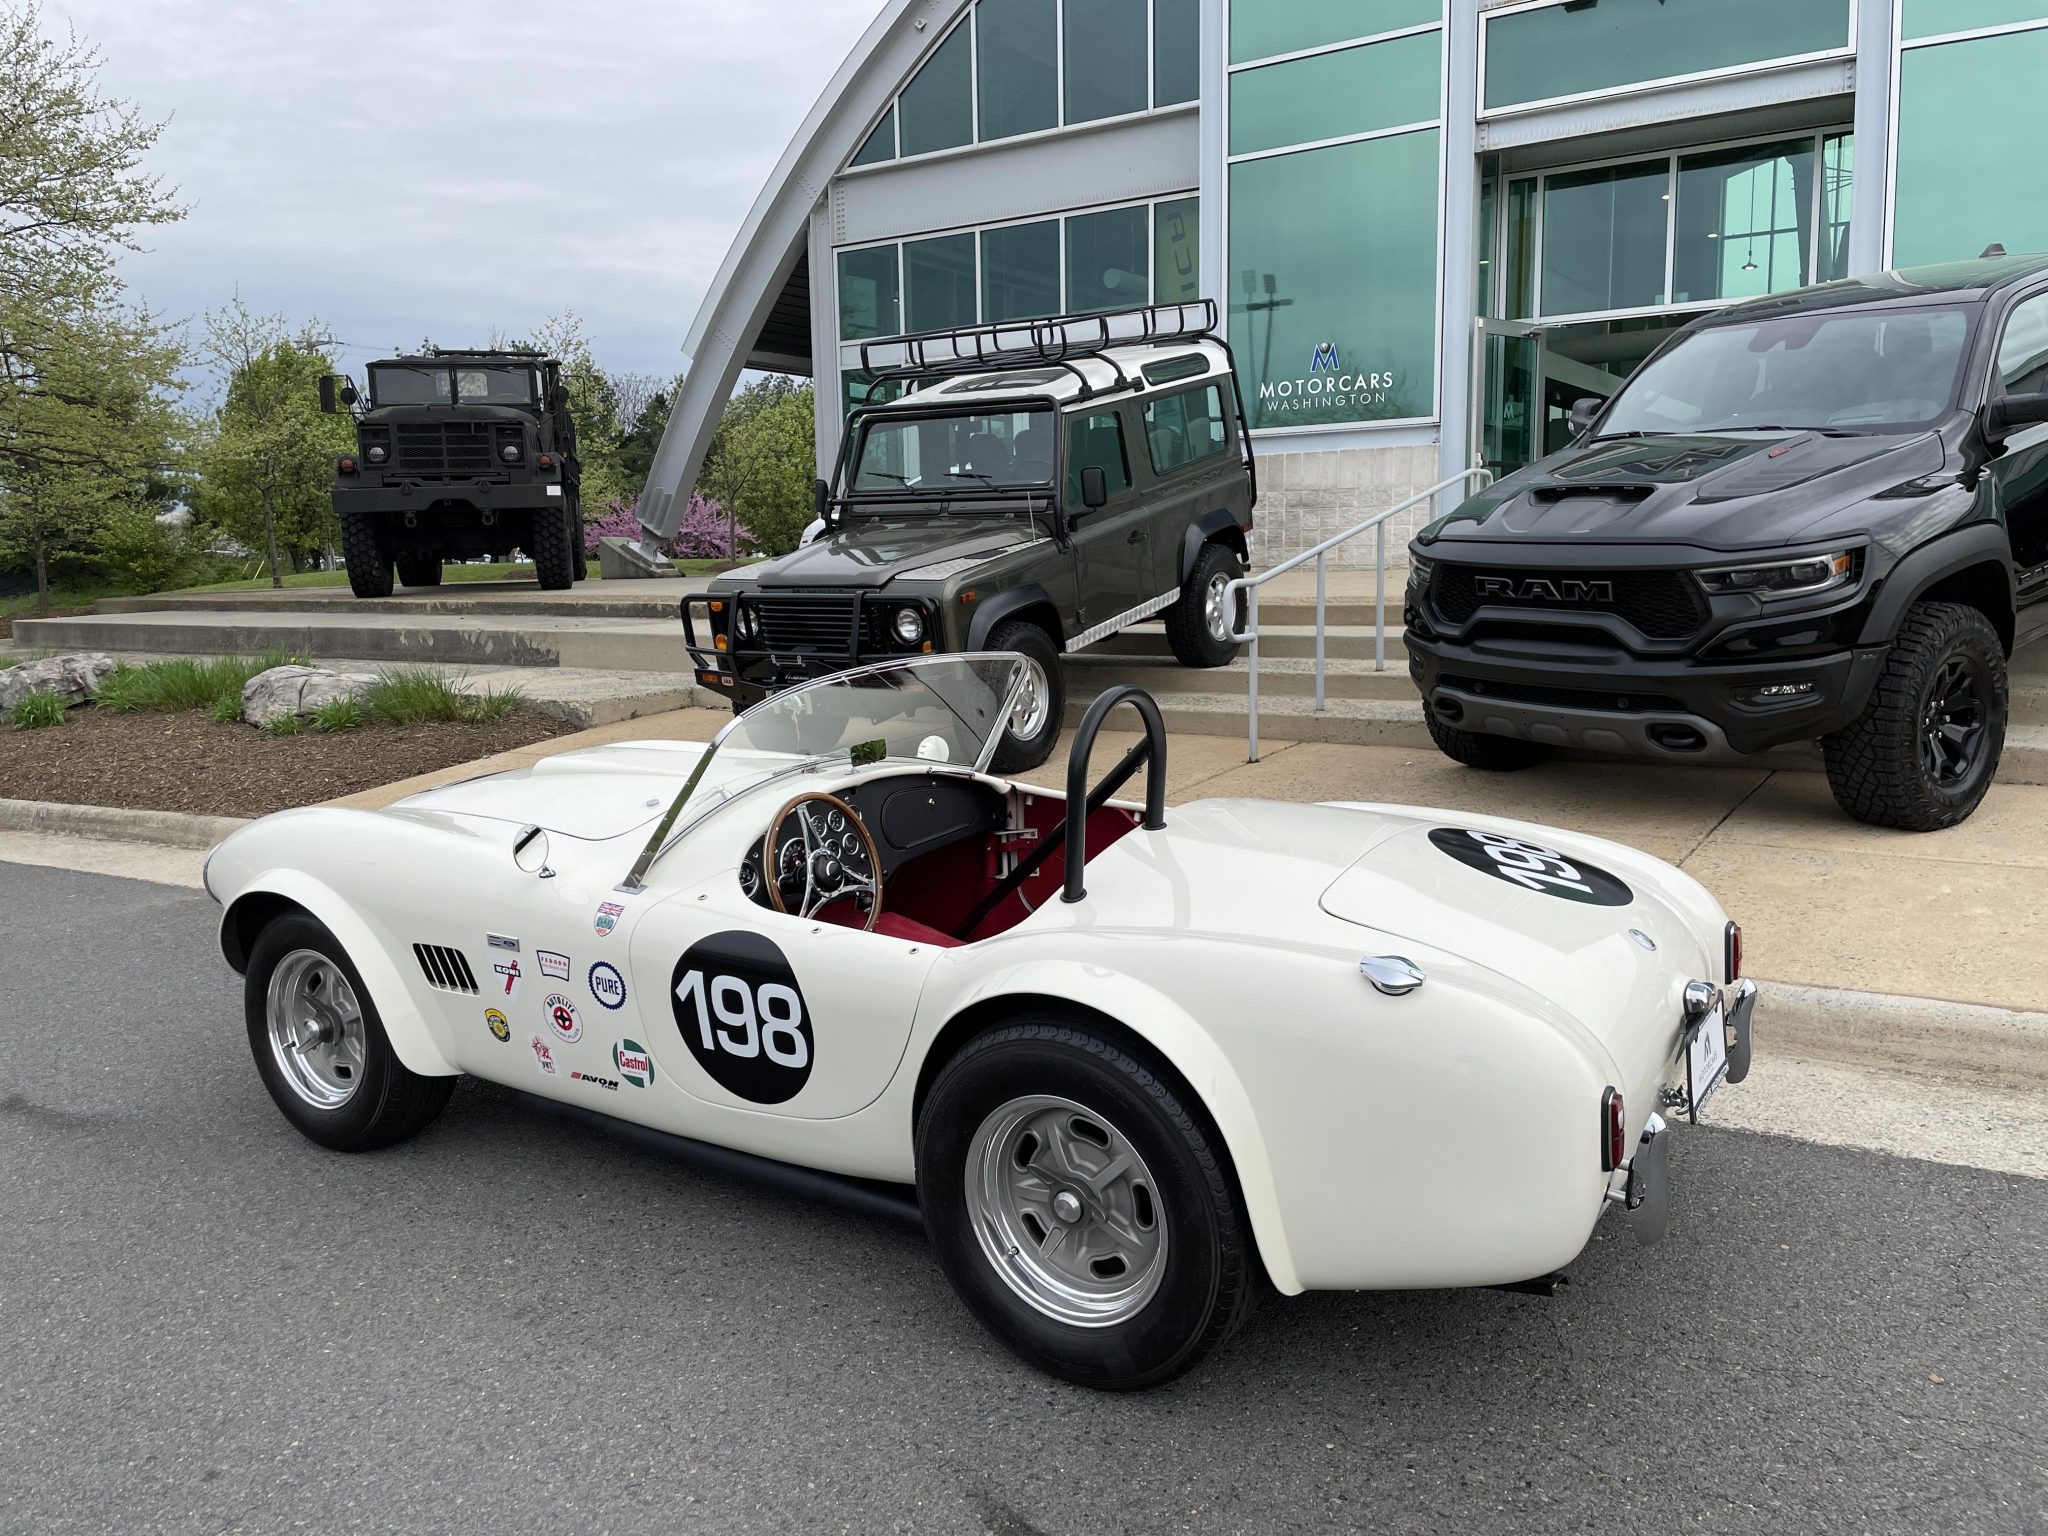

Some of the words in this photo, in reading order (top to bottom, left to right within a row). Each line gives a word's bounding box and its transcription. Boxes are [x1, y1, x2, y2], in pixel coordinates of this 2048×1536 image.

[1259, 371, 1393, 399] MOTORCARS
[1267, 392, 1386, 411] WASHINGTON
[1475, 576, 1613, 602] RAM
[1466, 831, 1594, 894] 198
[495, 965, 521, 977] KONI
[595, 976, 620, 996] PURE
[547, 996, 575, 1014] AUTOLITE
[675, 969, 808, 1069] 198
[619, 1050, 649, 1072] Castrol
[581, 1074, 619, 1088] AVON
